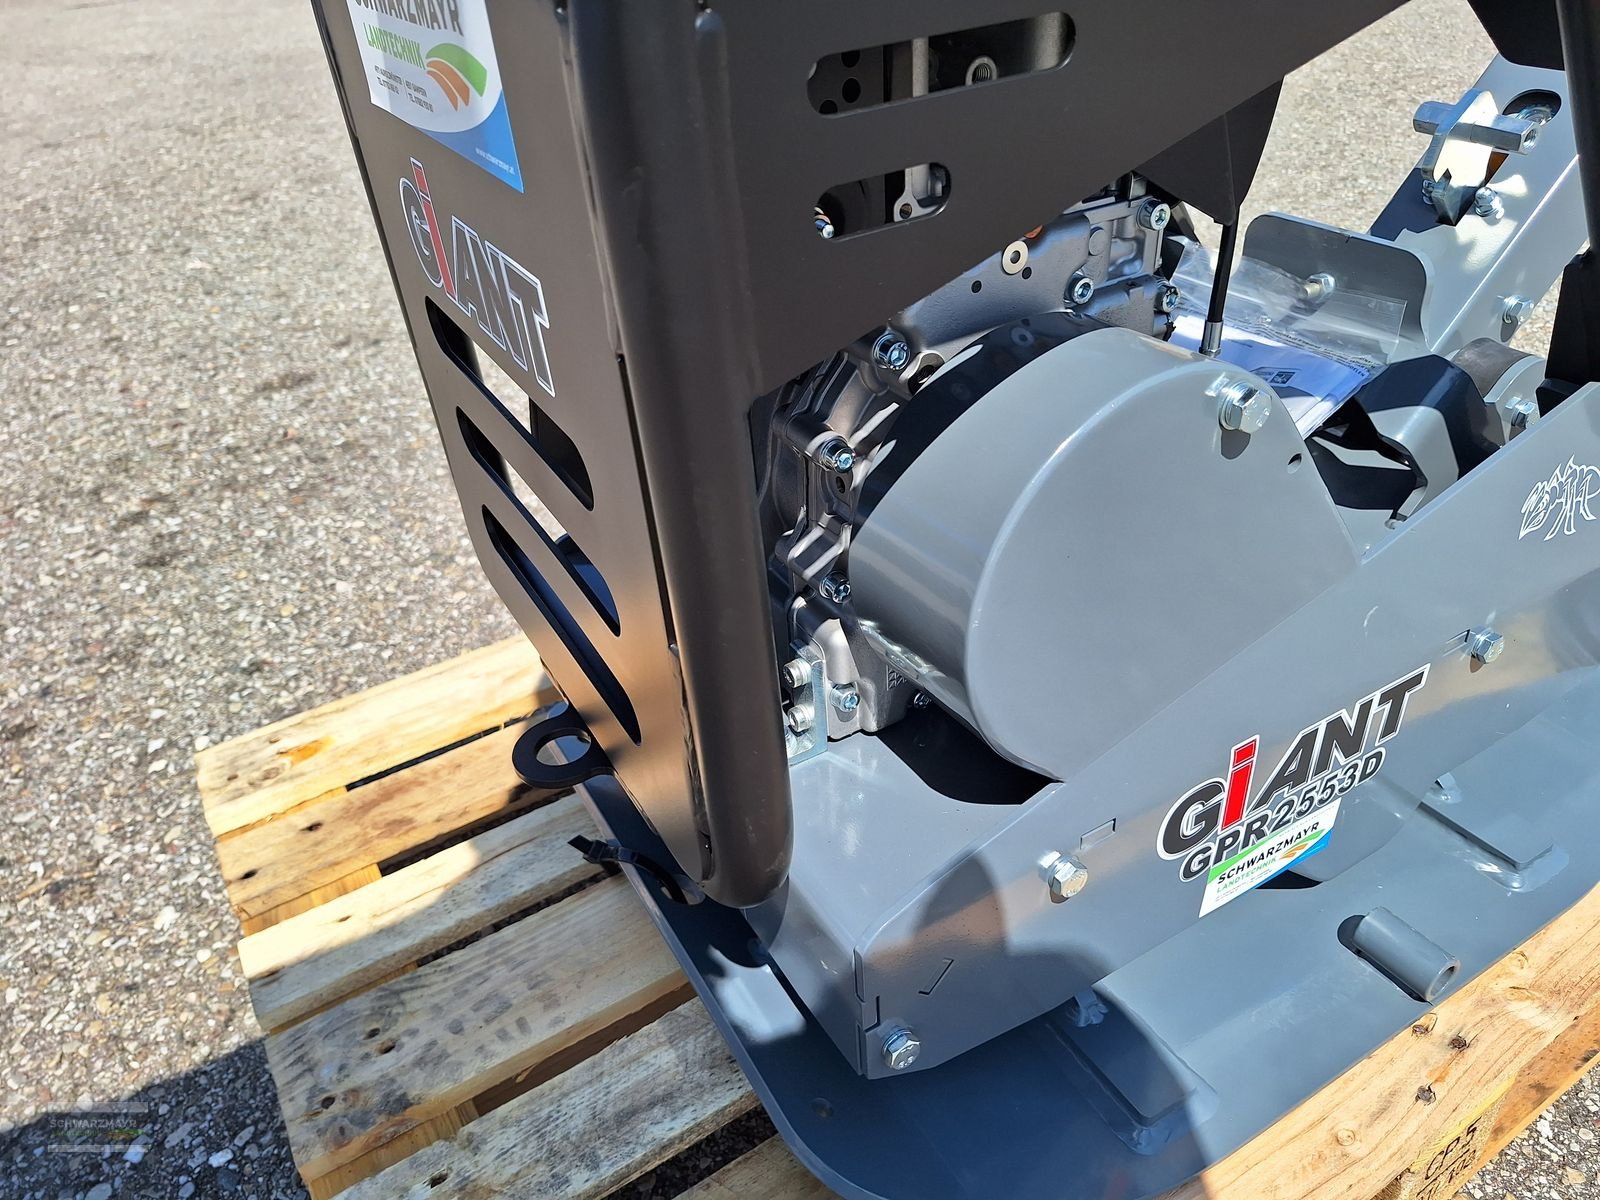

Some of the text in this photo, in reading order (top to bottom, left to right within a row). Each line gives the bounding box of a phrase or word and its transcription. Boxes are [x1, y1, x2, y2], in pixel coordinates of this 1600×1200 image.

[363, 22, 426, 70] LANDTECHNIK
[1179, 747, 1387, 882] GPR2553D
[1216, 857, 1276, 894] LANDTECHNIK
[1217, 821, 1320, 884] SCHWARZMAYR
